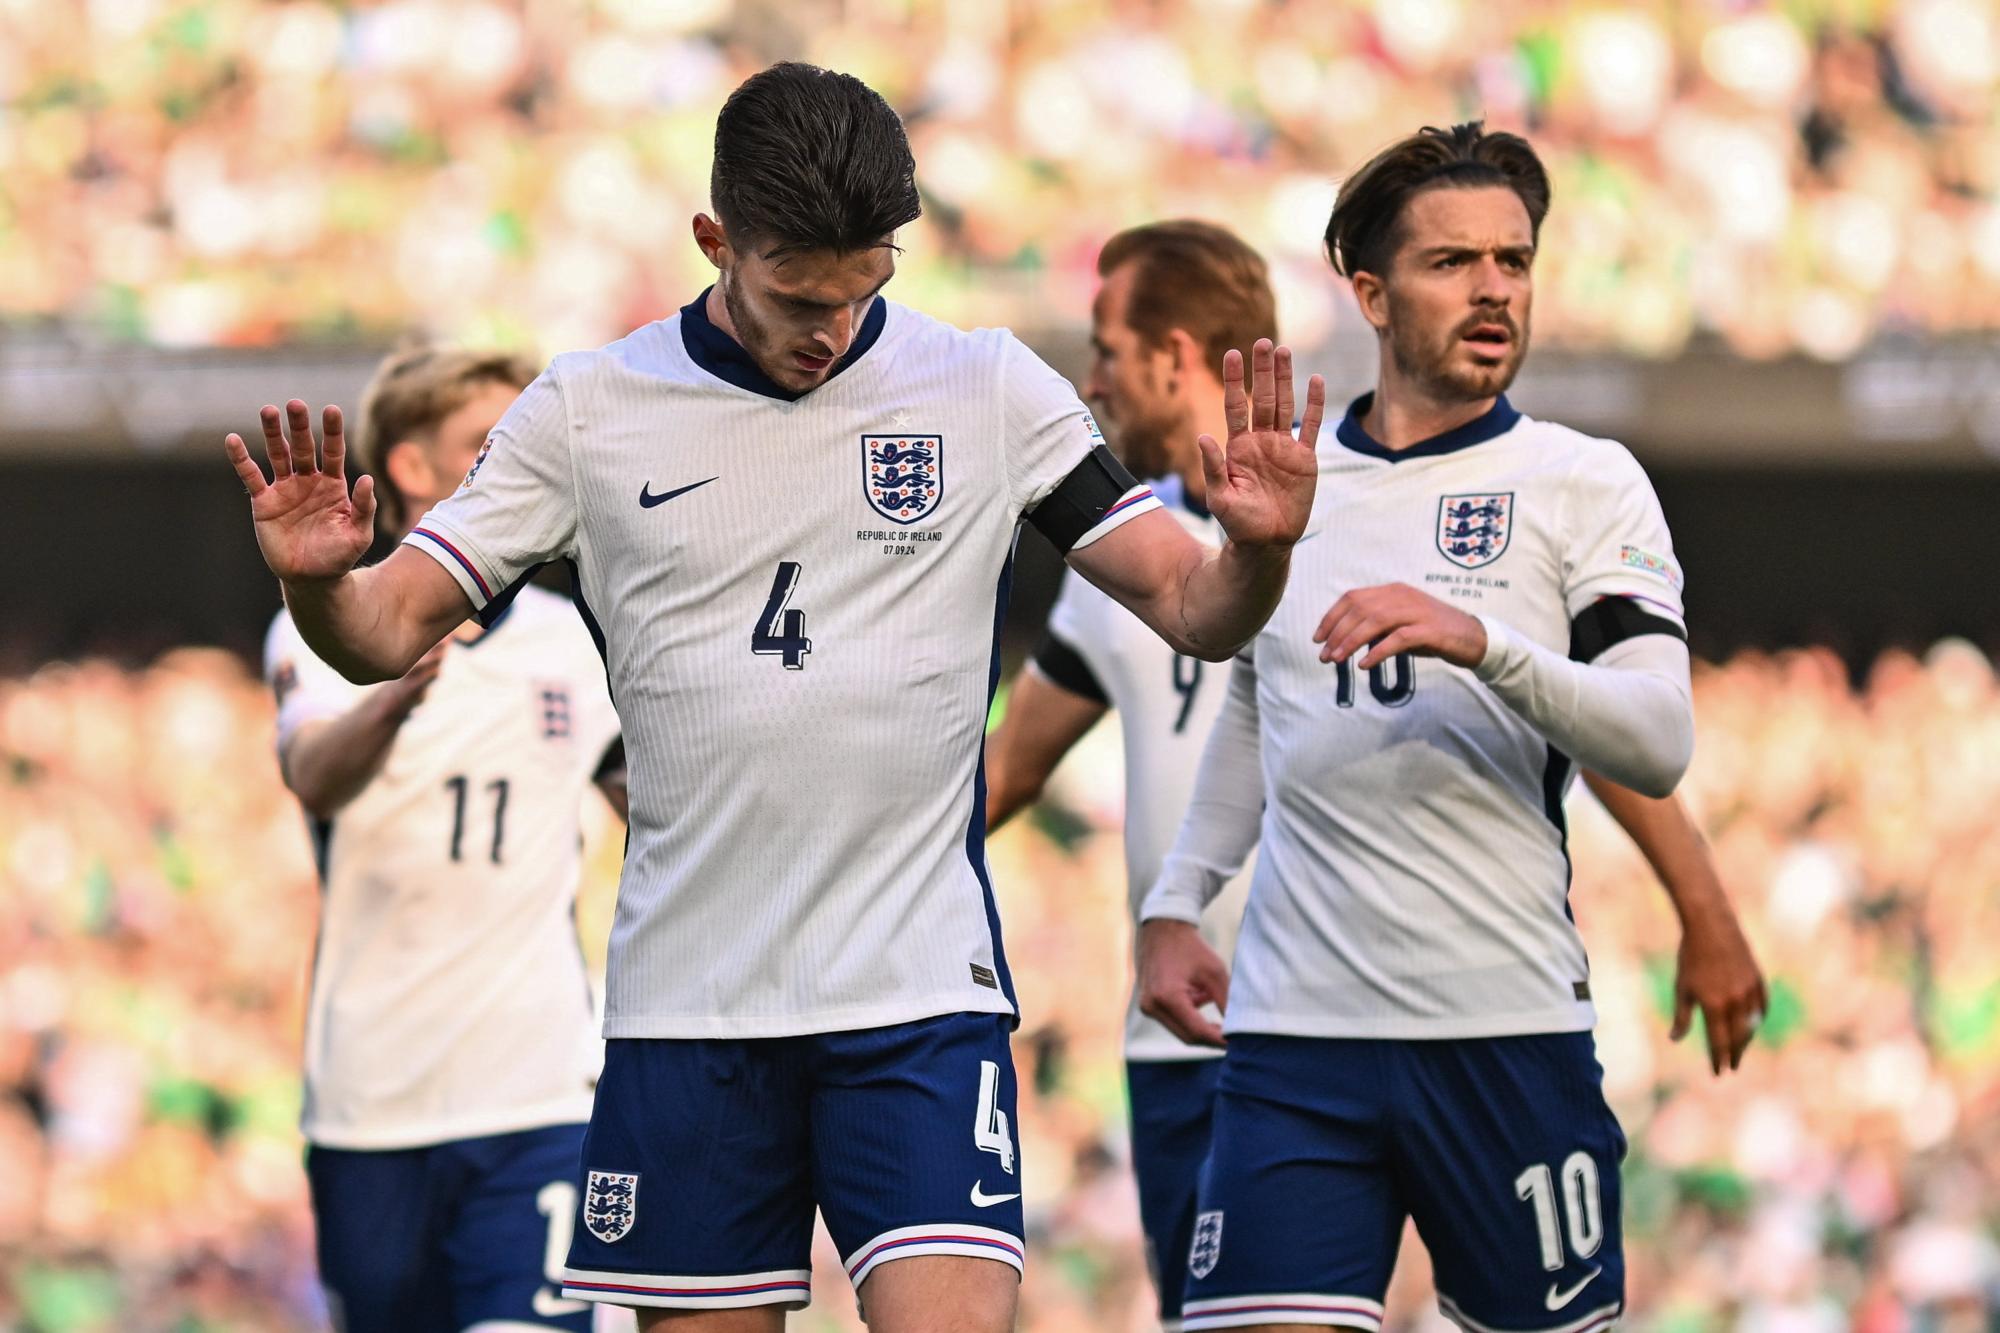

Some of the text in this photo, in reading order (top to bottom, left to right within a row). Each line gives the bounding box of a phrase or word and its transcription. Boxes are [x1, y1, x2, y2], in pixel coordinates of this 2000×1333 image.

[857, 530, 942, 541] REPUBLIC OF IRELAND
[883, 545, 915, 555] 07.09.24
[751, 561, 811, 670] 4
[1172, 652, 1203, 735] 9
[442, 775, 509, 864] 11
[974, 1060, 1015, 1176] 4
[1514, 1150, 1604, 1272] 10
